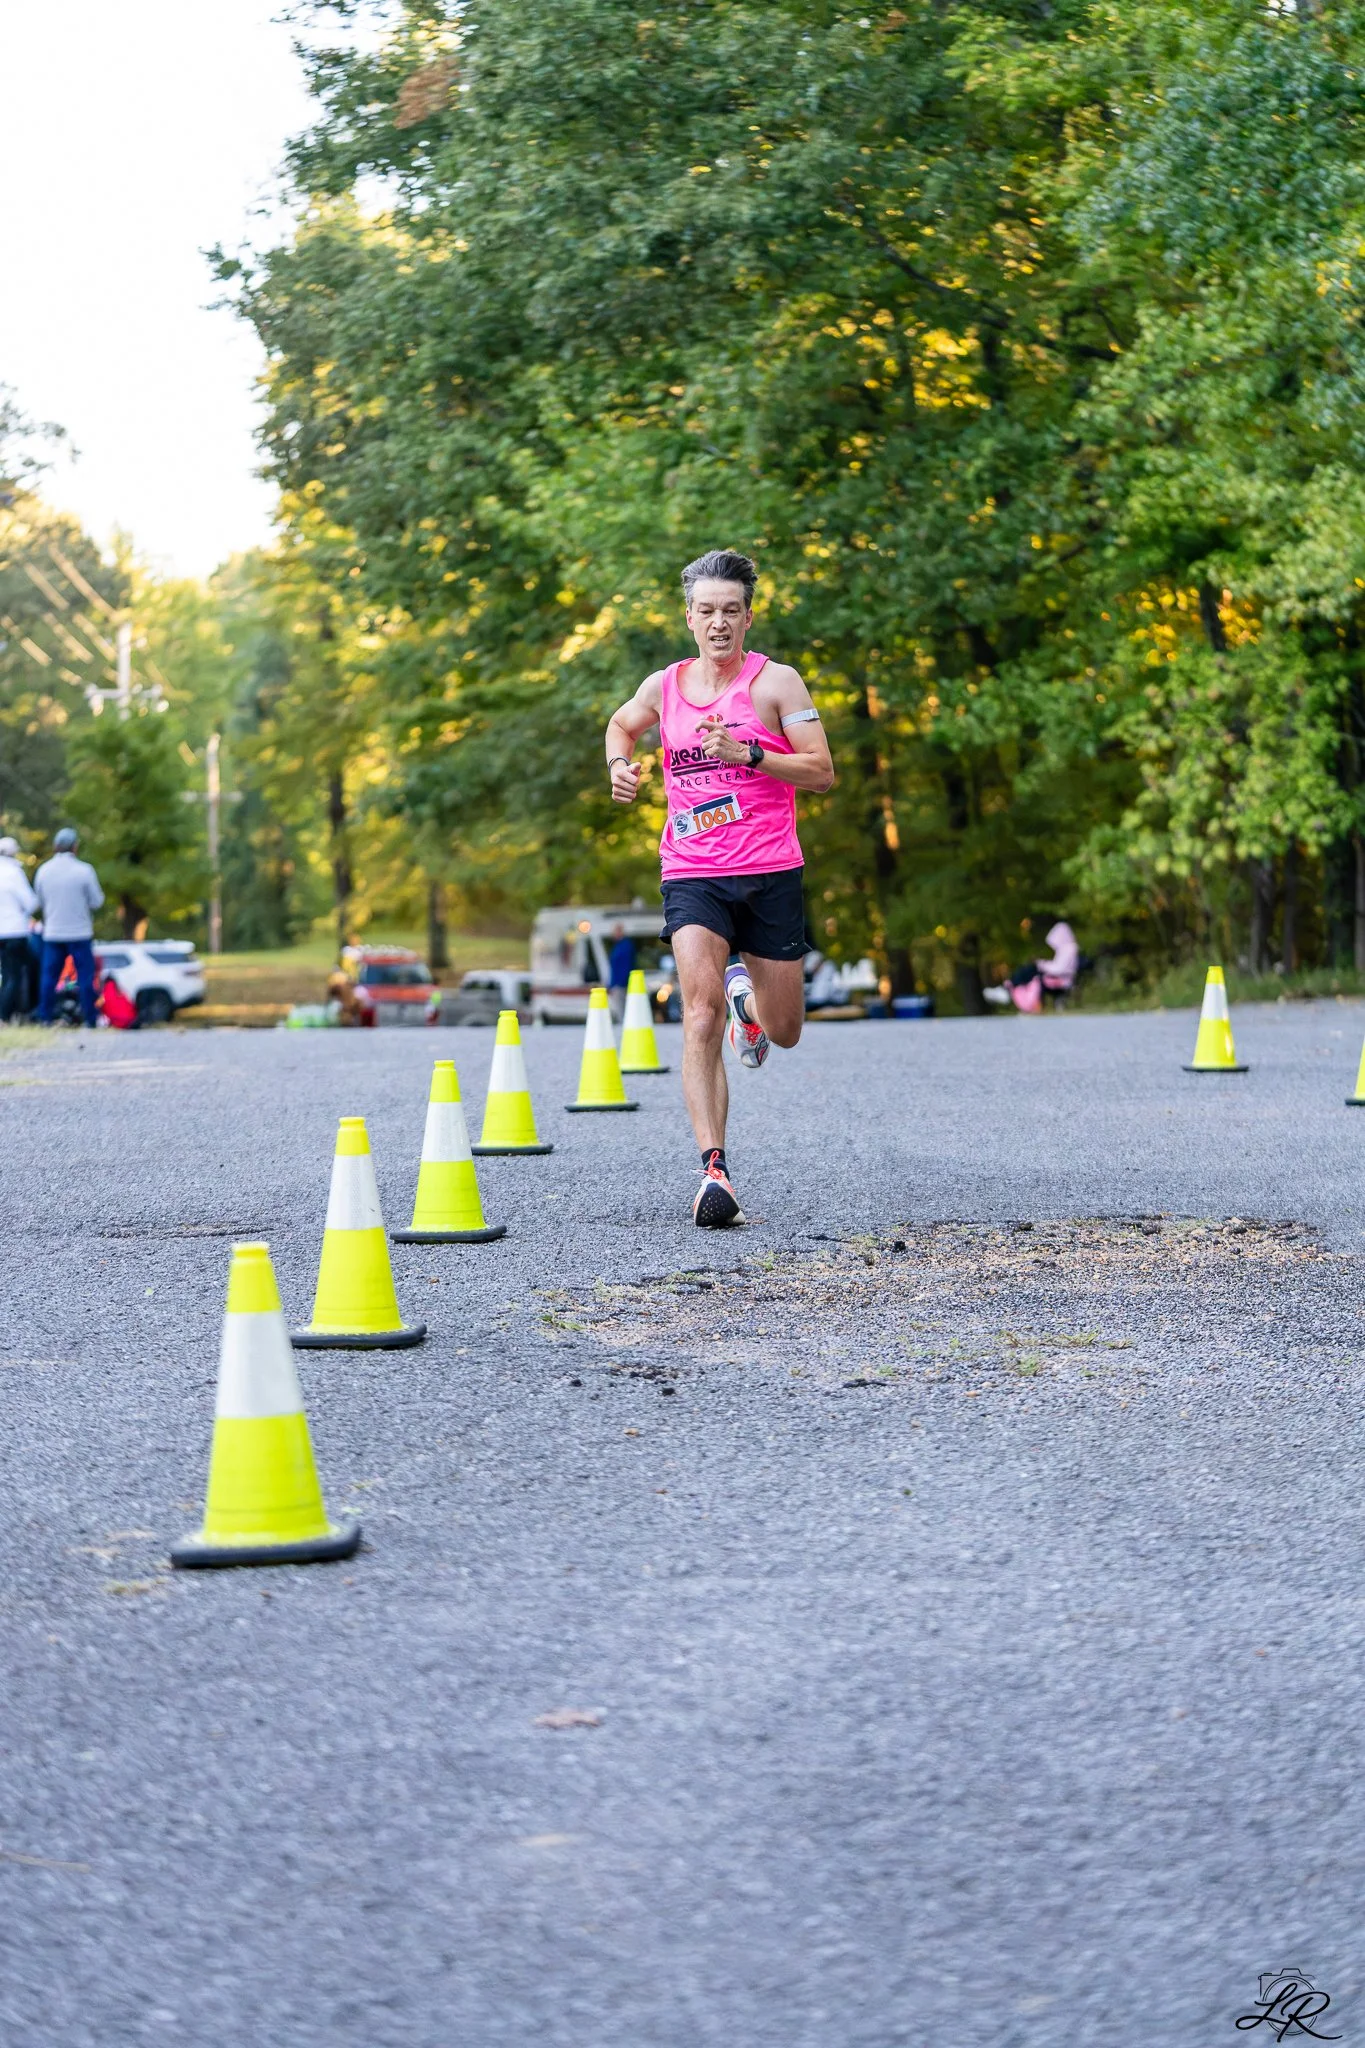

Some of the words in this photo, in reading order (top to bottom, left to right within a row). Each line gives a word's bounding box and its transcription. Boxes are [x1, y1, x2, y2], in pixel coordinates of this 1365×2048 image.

[680, 775, 710, 788] RACE
[717, 769, 755, 782] TEAM
[693, 804, 736, 831] 1061
